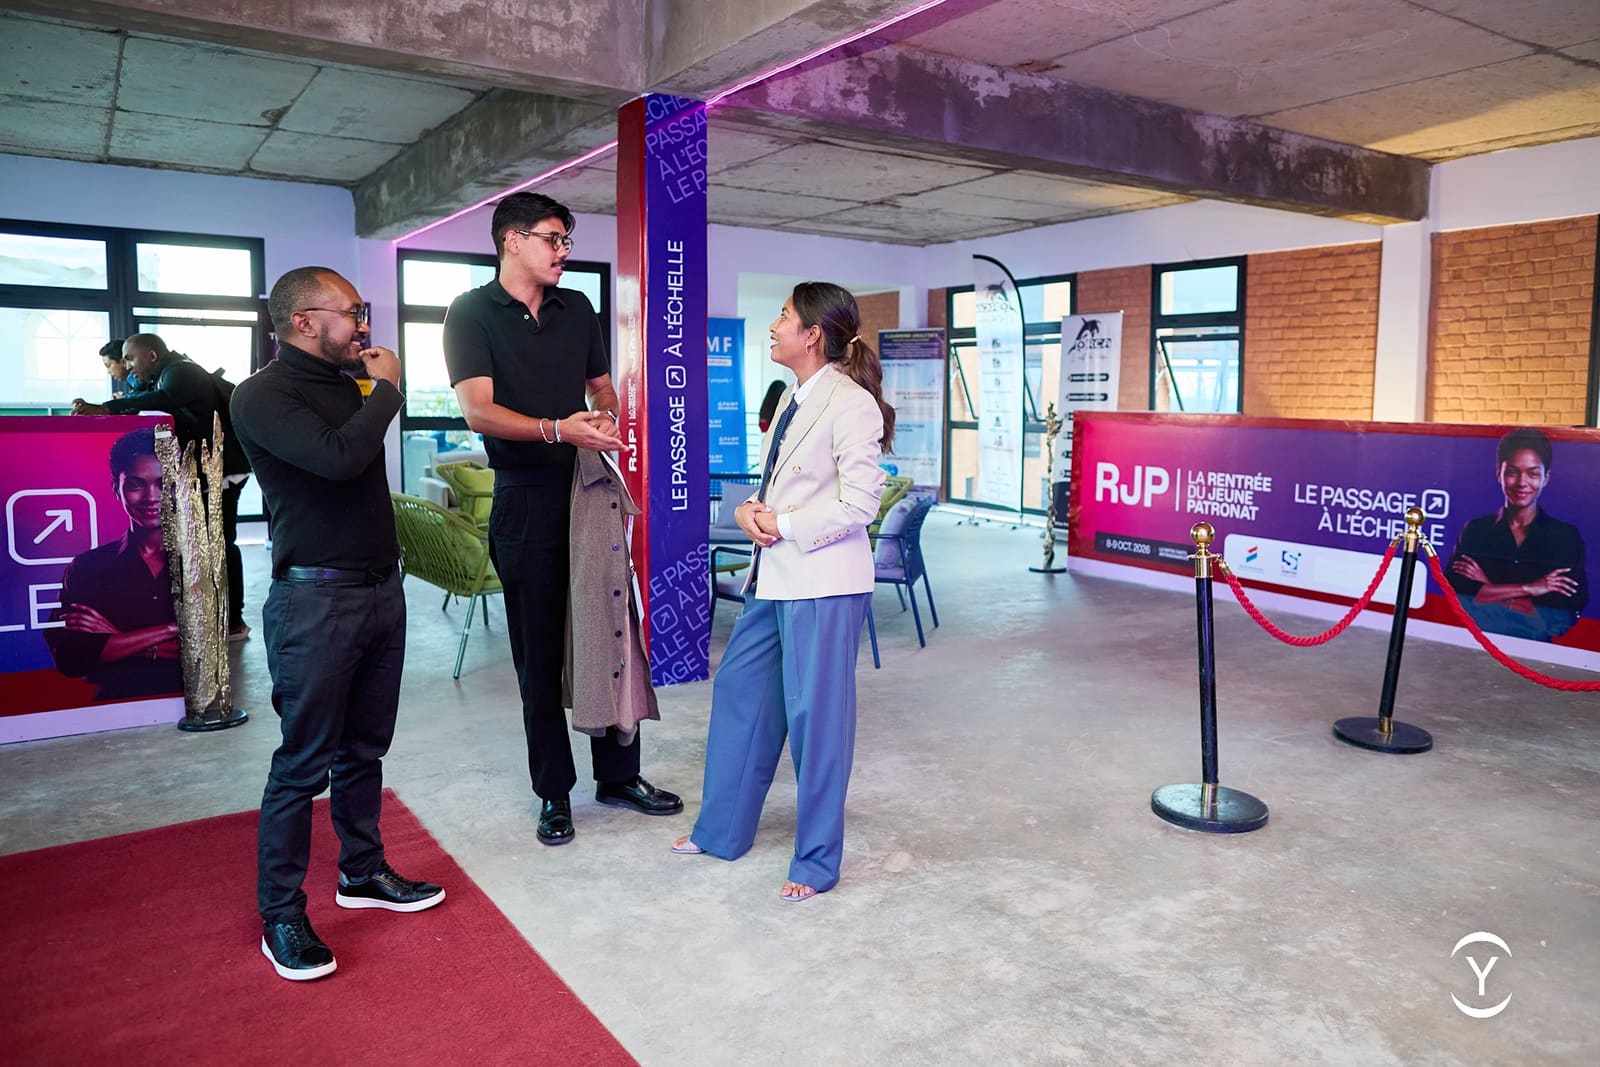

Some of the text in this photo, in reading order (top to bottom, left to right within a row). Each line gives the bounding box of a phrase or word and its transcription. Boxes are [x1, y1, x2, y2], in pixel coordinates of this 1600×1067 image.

[645, 107, 707, 155] PASSA
[655, 154, 676, 181] À
[666, 176, 695, 204] LE
[663, 239, 688, 511] LE PASSAGE À L'ÉCHELLE
[628, 428, 637, 473] RJP
[1095, 461, 1170, 508] RJP
[1187, 470, 1272, 492] LA RENTRÉE
[1187, 485, 1254, 505] DU JEUNE
[1186, 500, 1259, 521] PATRONAT
[1294, 483, 1417, 514] LE PASSAGE
[1317, 507, 1445, 546] À L'ÉCHEE
[650, 575, 667, 602] E
[674, 586, 695, 610] À
[685, 603, 710, 632] LE
[652, 651, 700, 687] AGE
